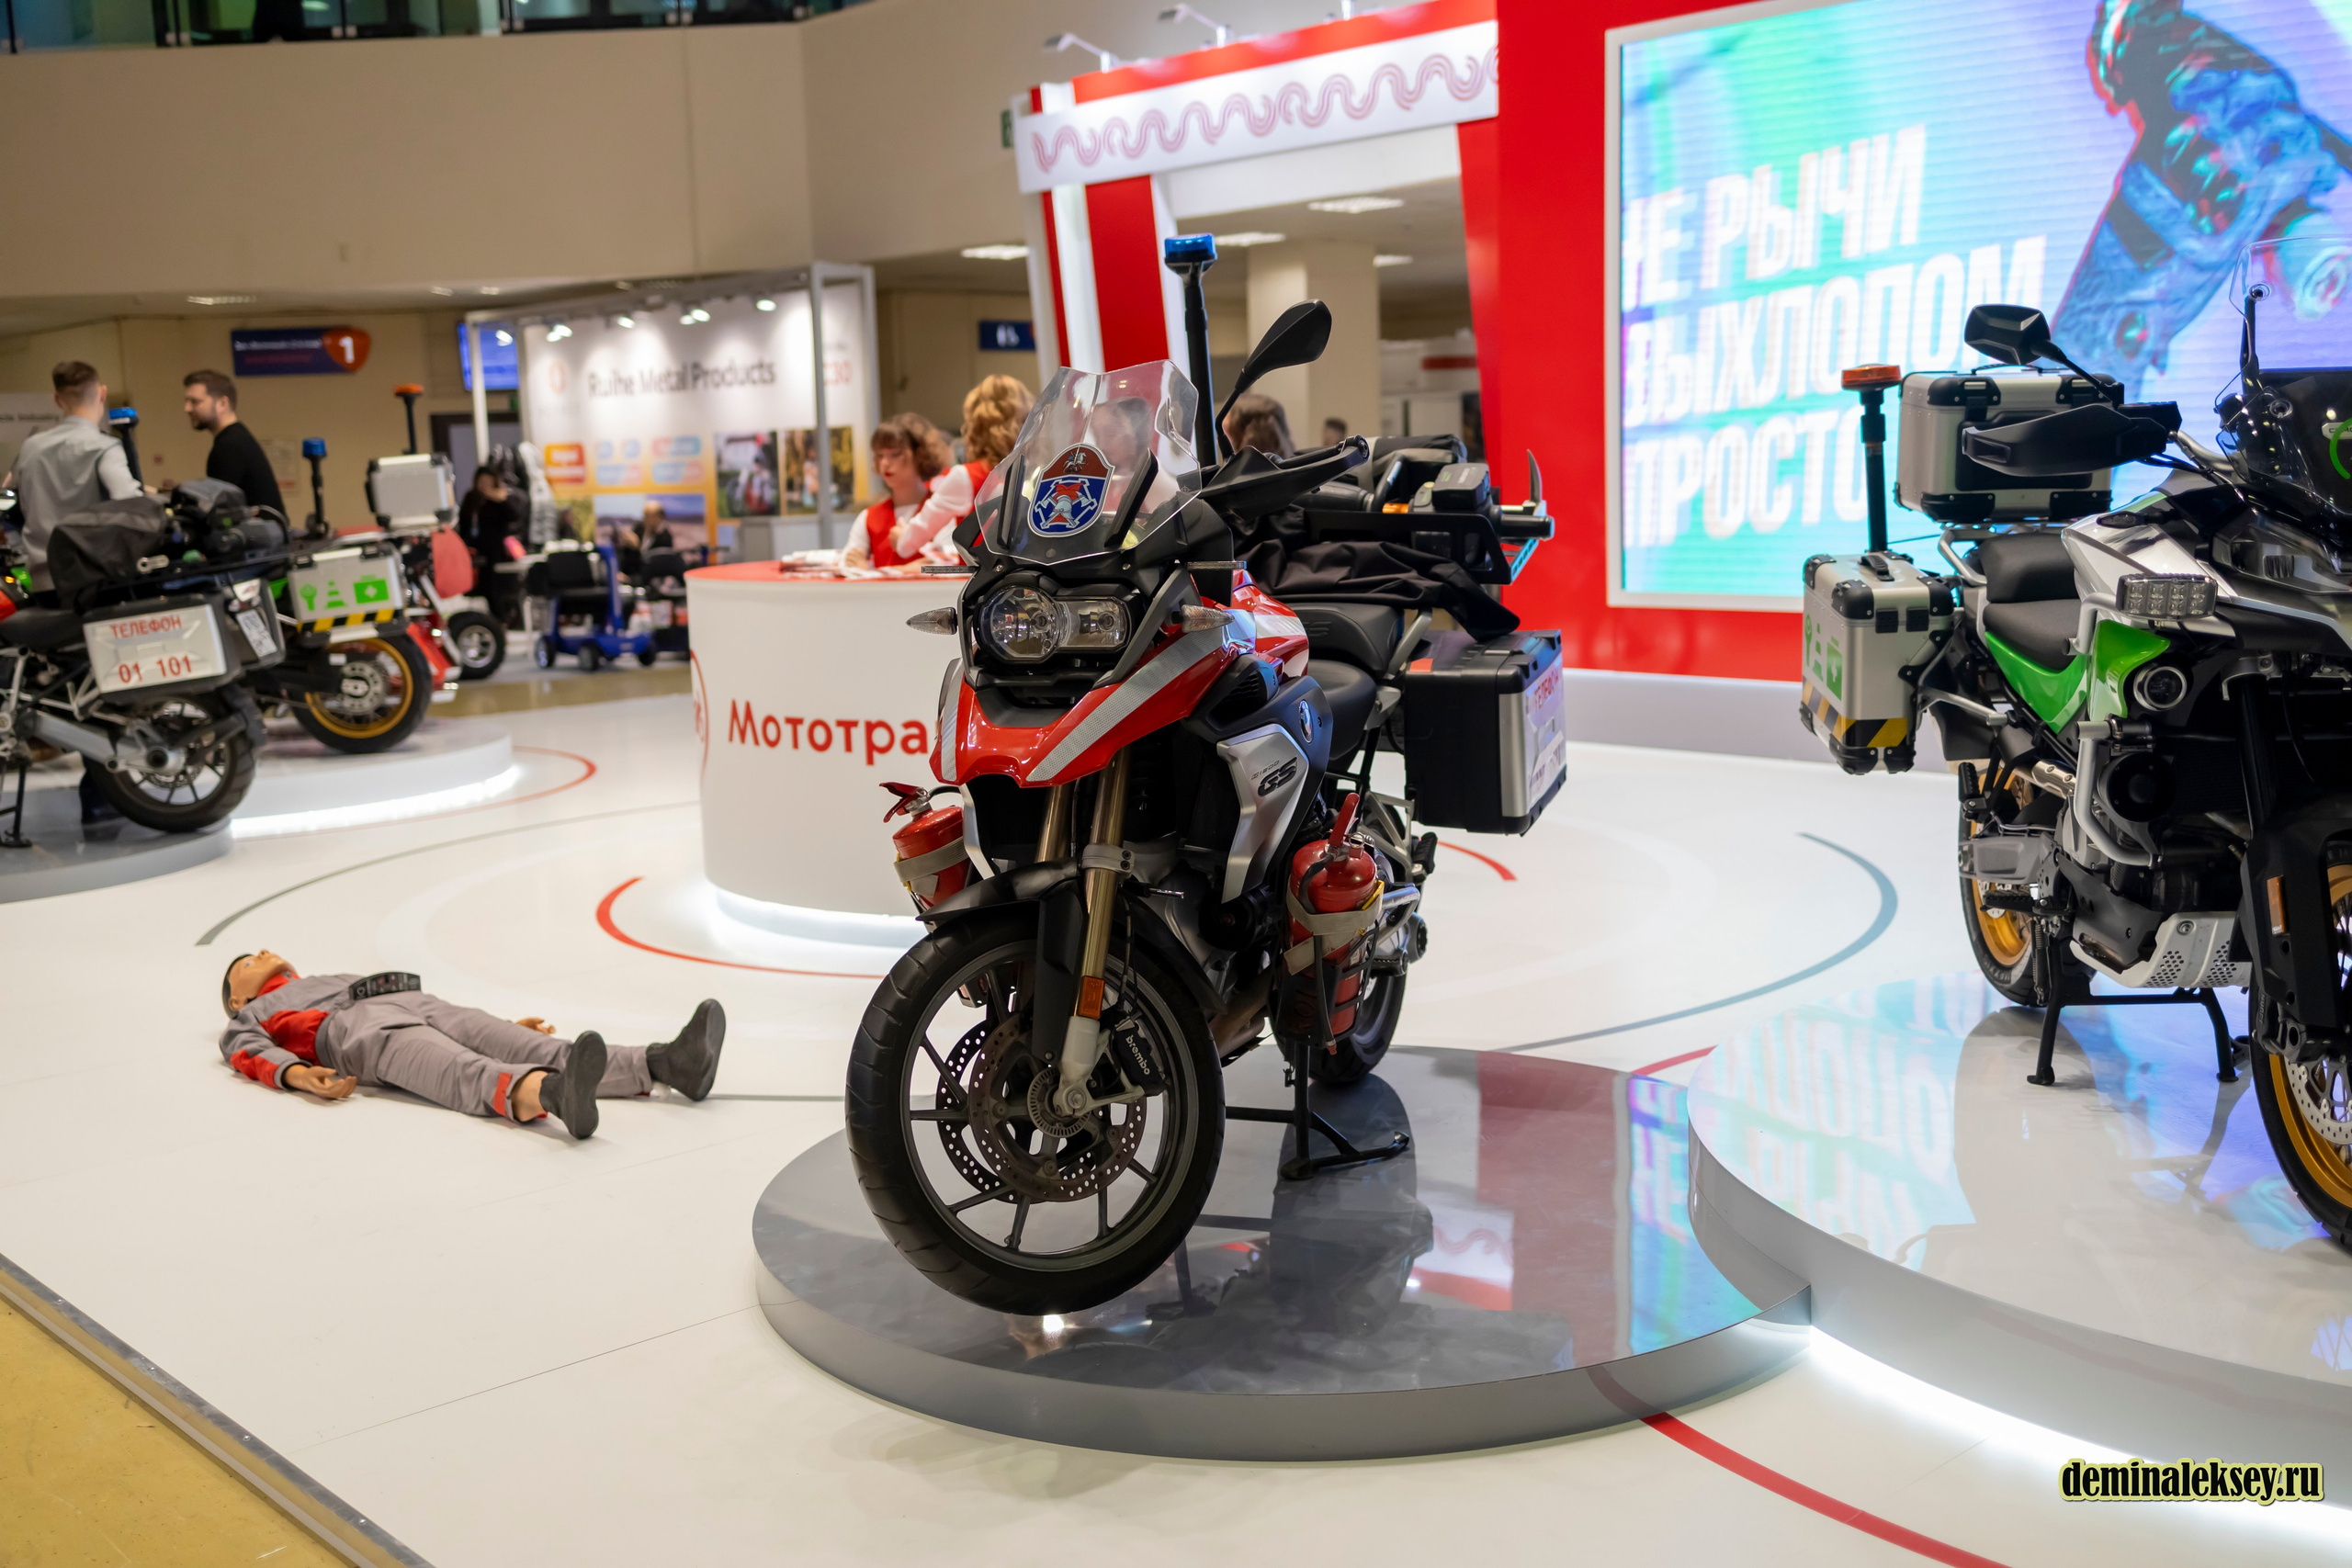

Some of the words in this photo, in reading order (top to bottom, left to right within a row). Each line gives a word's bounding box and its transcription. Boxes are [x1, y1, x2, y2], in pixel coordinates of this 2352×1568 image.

[1700, 123, 1926, 290] РЫЧИ
[339, 336, 355, 364] 1
[1623, 234, 2047, 429] ВЫХЛОПОМ
[588, 369, 635, 397] Ruihe
[639, 363, 687, 394] Metal
[692, 358, 776, 389] Products
[1623, 404, 1870, 548] ПРОСТО
[110, 616, 182, 639] ТЕЛЕФОН
[119, 663, 143, 683] 01
[157, 656, 193, 678] 101
[729, 698, 929, 766] Мототра
[1258, 757, 1297, 797] GS
[1125, 1034, 1150, 1075] brembo
